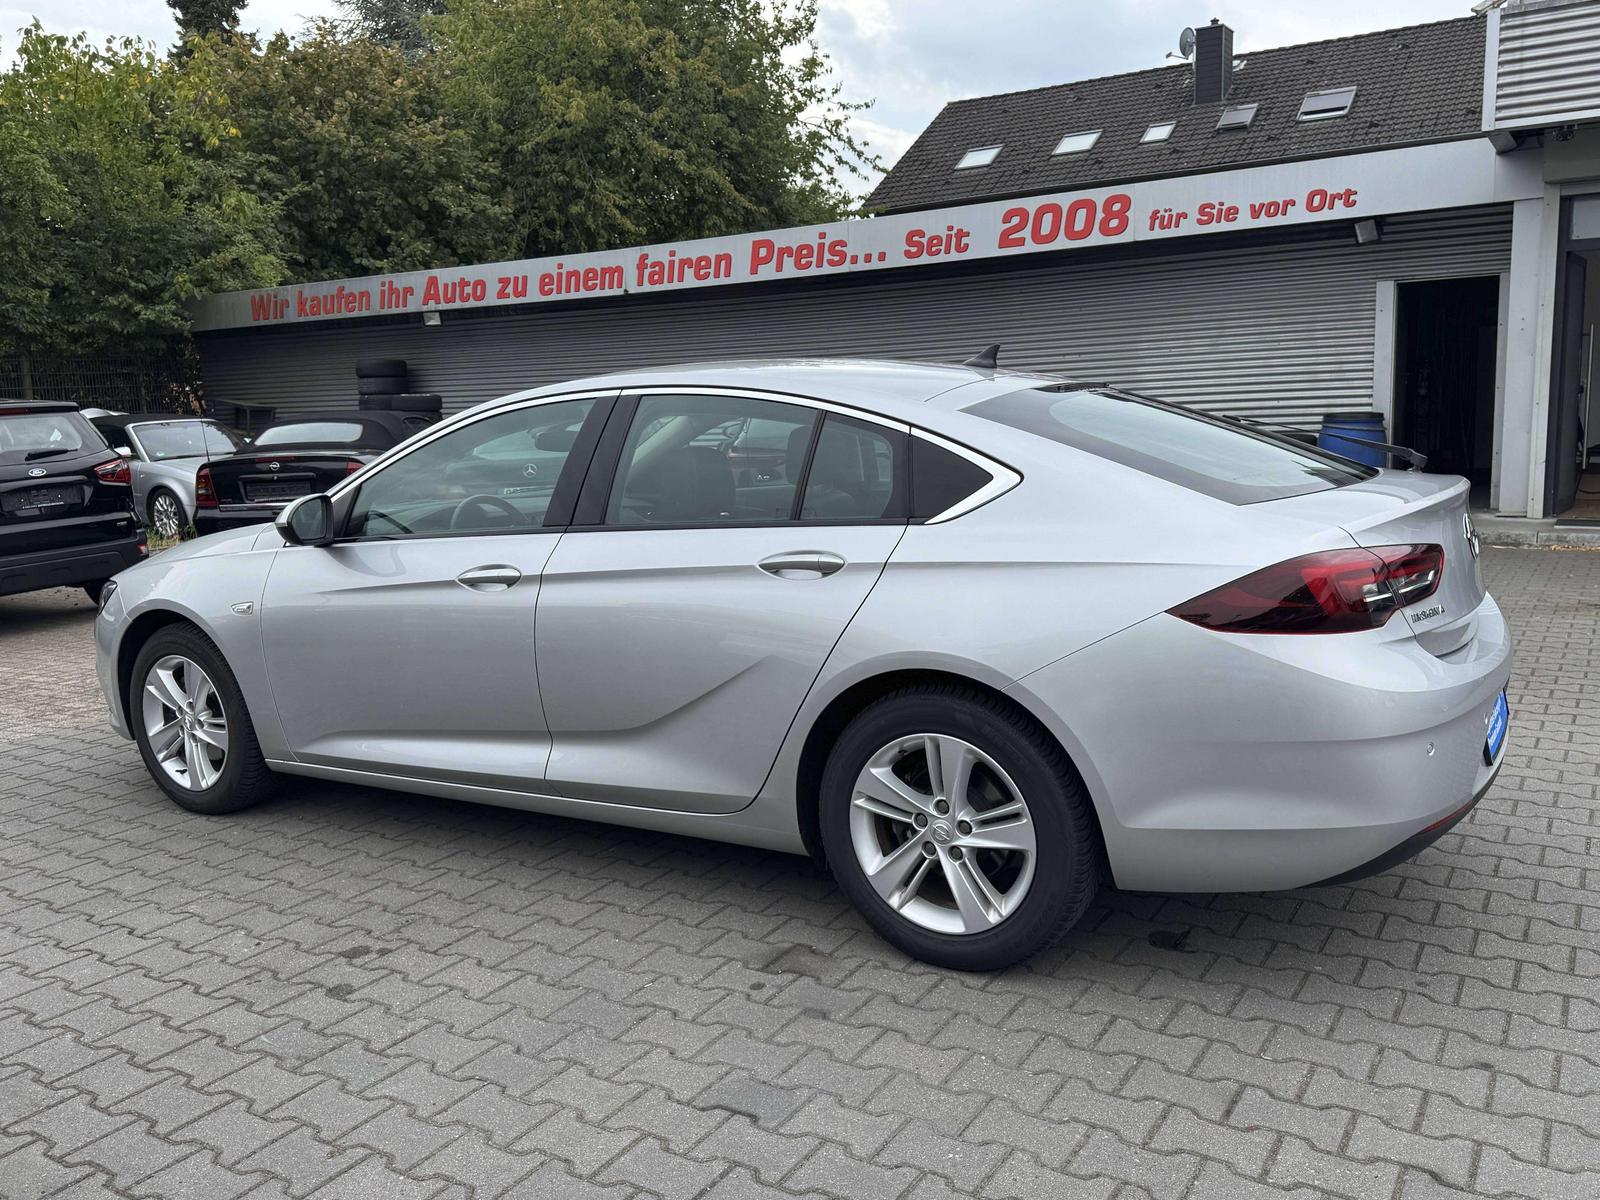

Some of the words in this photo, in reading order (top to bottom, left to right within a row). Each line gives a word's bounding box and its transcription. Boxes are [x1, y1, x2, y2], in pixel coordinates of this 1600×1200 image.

[250, 294, 289, 321] Wir
[297, 286, 371, 318] kaufen
[379, 280, 414, 310] ihr
[422, 275, 487, 306] Auto
[496, 275, 528, 300] zu
[539, 263, 624, 297] einem
[636, 250, 733, 288] fairen
[749, 231, 887, 276] Preis...
[903, 224, 970, 260] Seit
[998, 194, 1133, 249] 2008
[1148, 208, 1188, 232] für
[1196, 202, 1239, 226] Sie
[1249, 199, 1296, 220] vor
[1305, 188, 1358, 213] Ort
